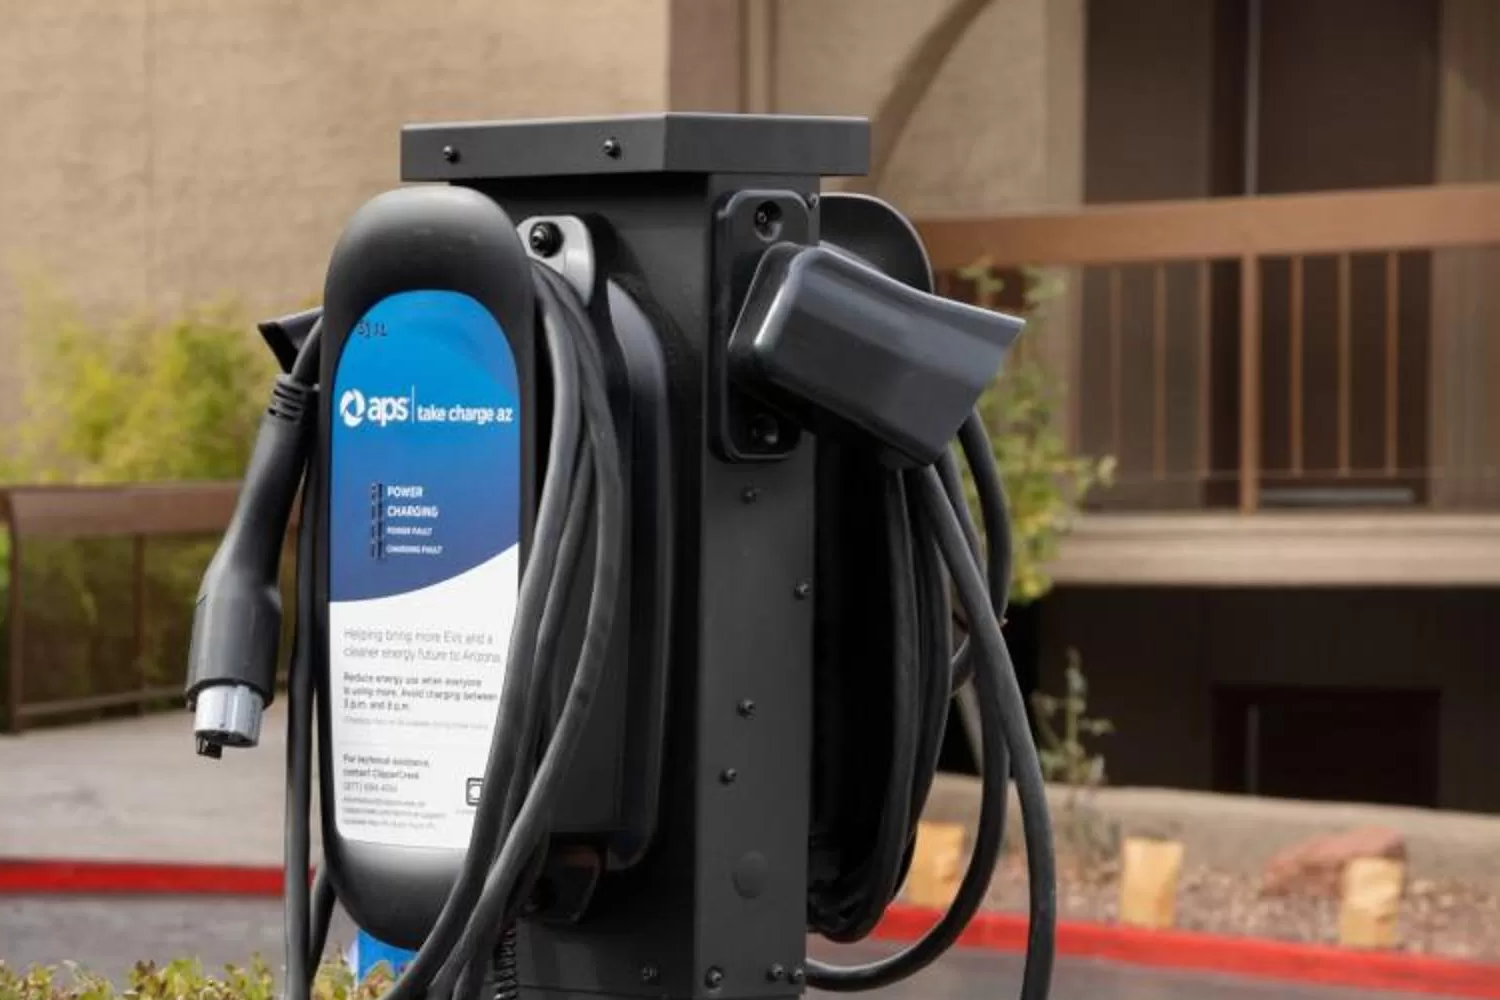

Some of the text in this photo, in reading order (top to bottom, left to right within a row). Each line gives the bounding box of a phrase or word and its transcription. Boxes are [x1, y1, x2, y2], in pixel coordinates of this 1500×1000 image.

[367, 396, 513, 426] aps take charge az
[387, 485, 423, 498] POWER
[387, 504, 439, 518] CHARGING
[343, 630, 383, 644] Helping
[386, 630, 413, 645] bring
[416, 632, 442, 643] more
[465, 632, 485, 645] and
[343, 646, 379, 658] cleaner
[382, 648, 416, 662] energy
[417, 647, 448, 661] future
[343, 671, 373, 683] Reduce
